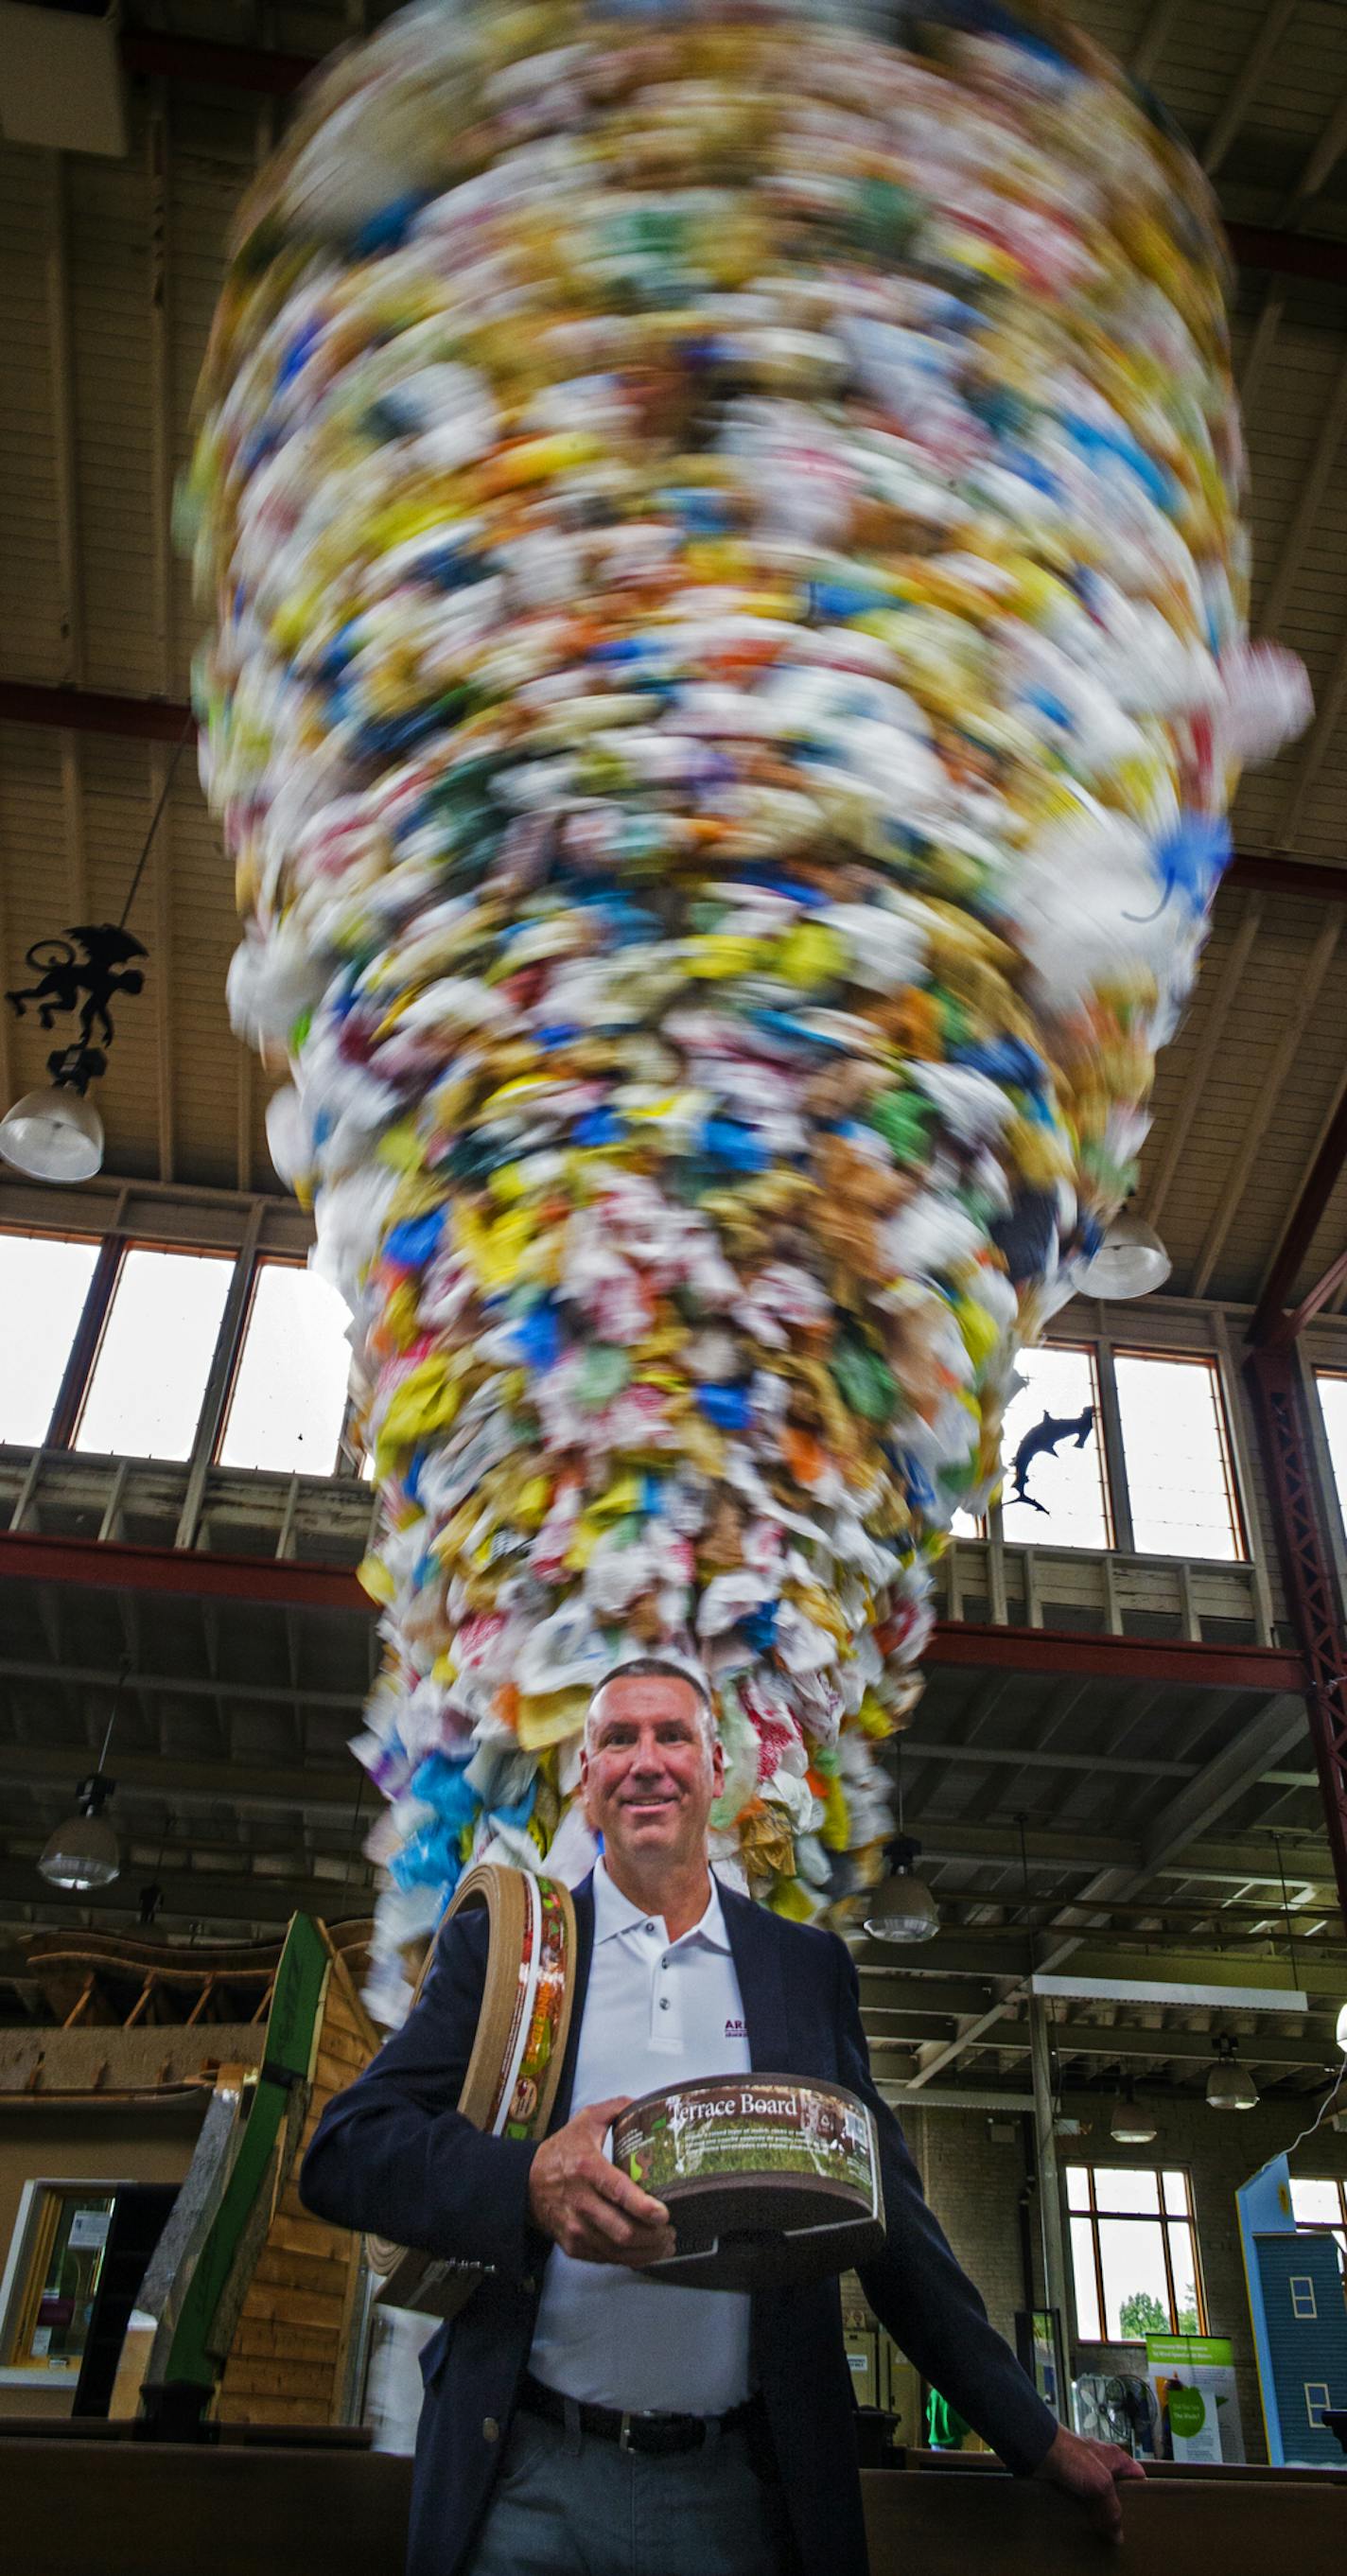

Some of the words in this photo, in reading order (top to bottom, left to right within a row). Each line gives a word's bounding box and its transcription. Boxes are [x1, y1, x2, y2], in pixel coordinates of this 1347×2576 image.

[726, 2020, 747, 2028] AR
[671, 2099, 735, 2120] Terrace
[741, 2094, 797, 2116] Board
